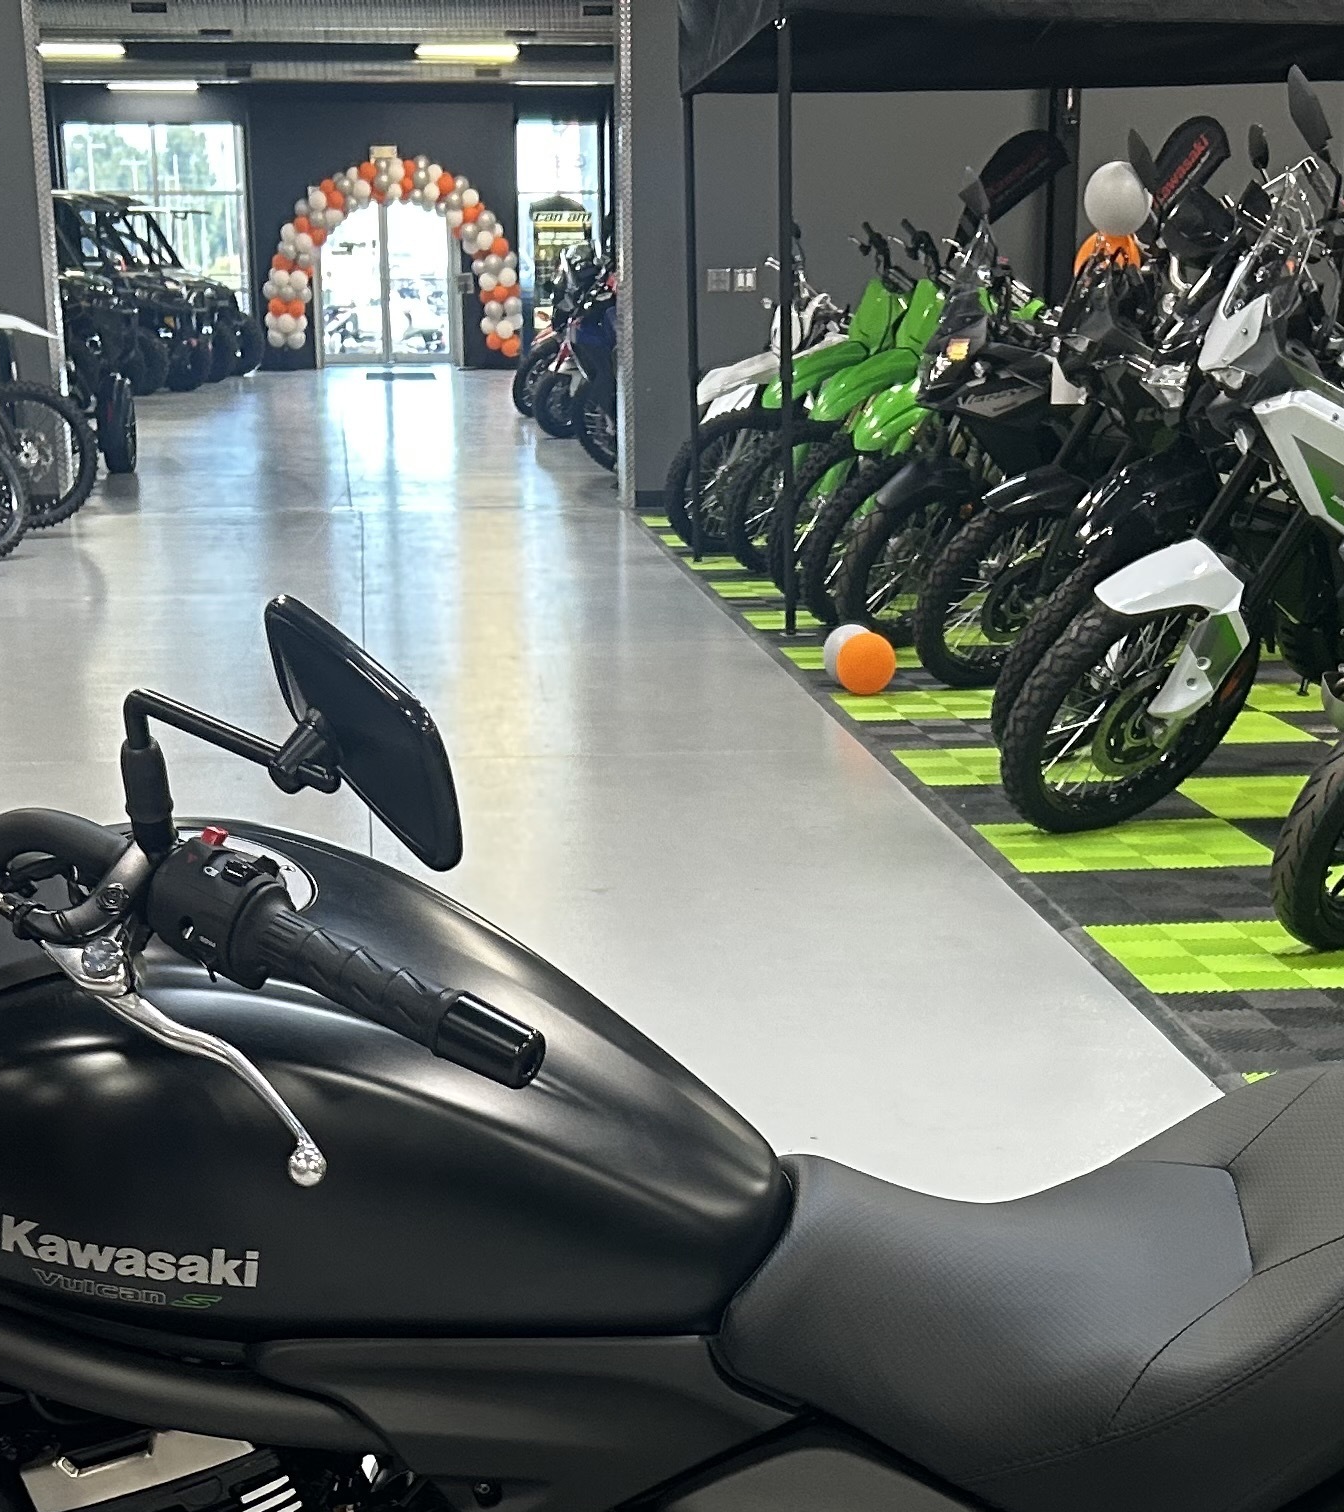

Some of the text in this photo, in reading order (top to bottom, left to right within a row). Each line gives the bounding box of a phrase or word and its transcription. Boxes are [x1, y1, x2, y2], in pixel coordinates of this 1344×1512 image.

[1, 1213, 260, 1288] Kawasaki
[32, 1267, 223, 1309] Vulcan S
